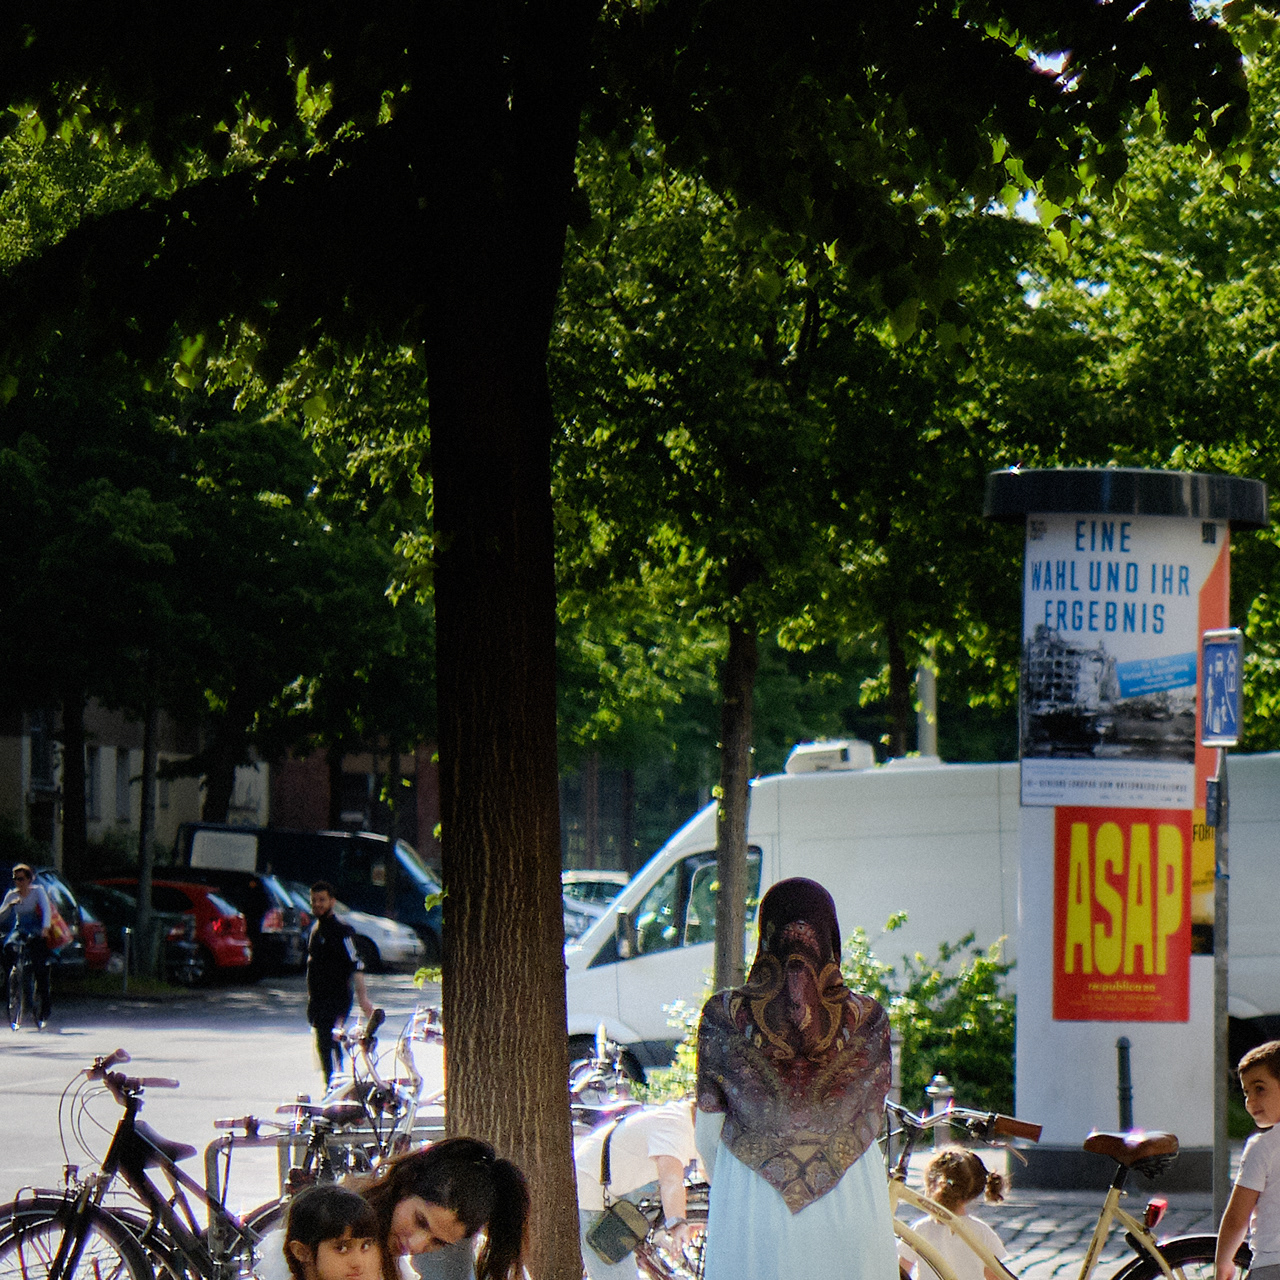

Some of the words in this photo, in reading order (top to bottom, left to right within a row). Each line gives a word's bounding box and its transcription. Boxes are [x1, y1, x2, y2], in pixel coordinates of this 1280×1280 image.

[1075, 520, 1132, 553] EINE
[1031, 560, 1080, 592] WAHL
[1089, 561, 1139, 593] UND
[1151, 563, 1190, 597] IHR
[1044, 599, 1166, 635] ERGEBNIS
[1064, 821, 1184, 976] ASAP
